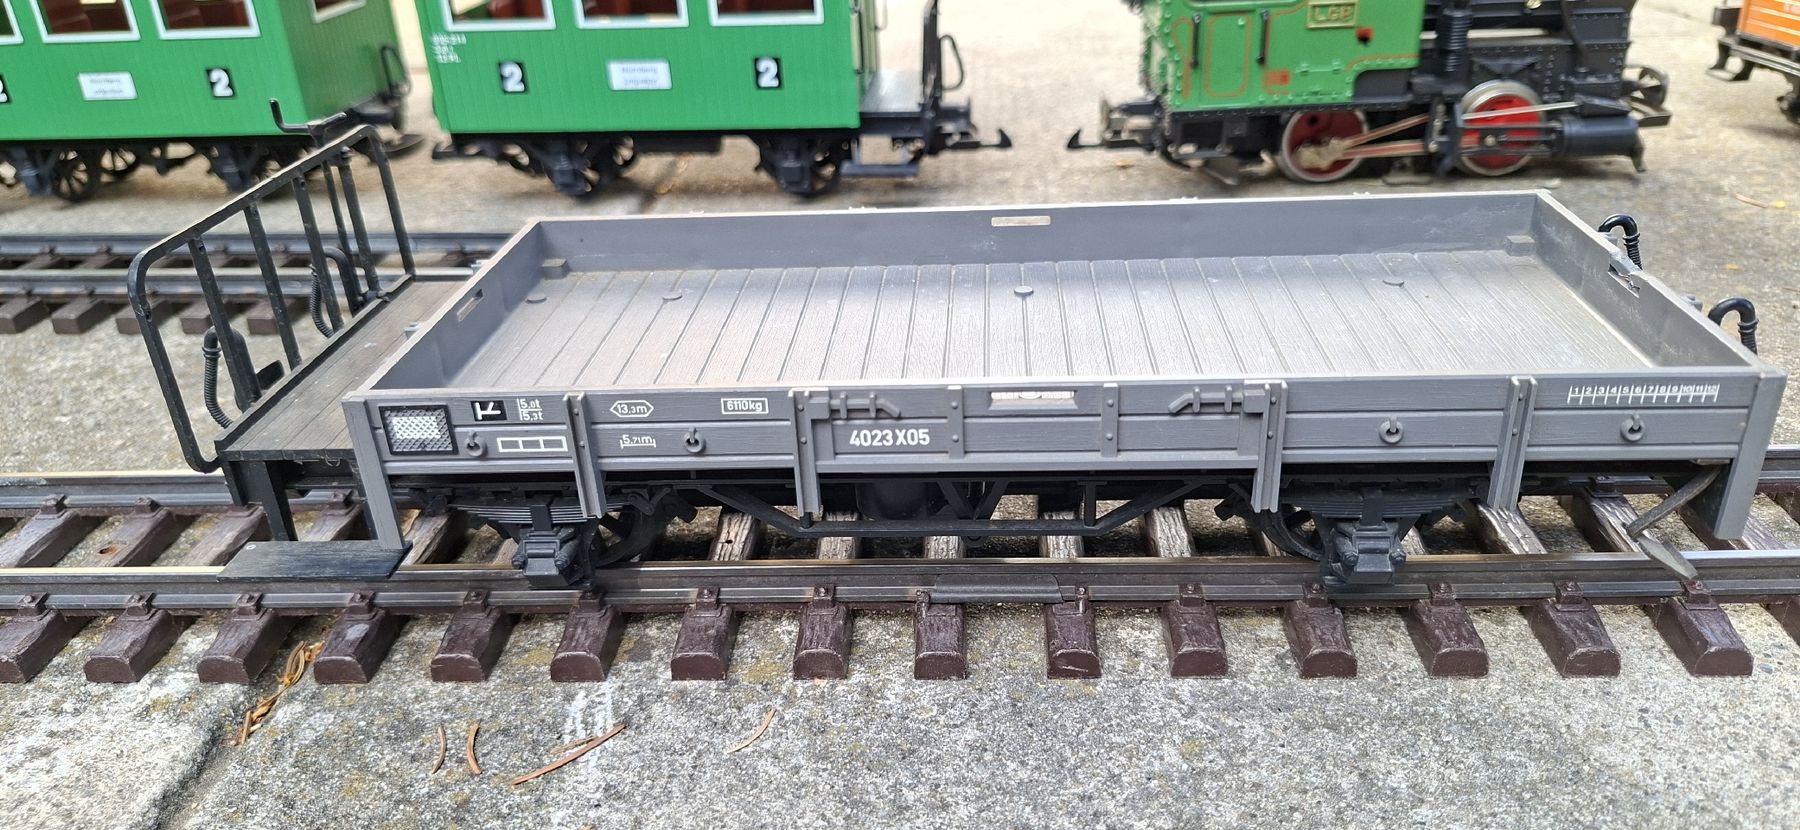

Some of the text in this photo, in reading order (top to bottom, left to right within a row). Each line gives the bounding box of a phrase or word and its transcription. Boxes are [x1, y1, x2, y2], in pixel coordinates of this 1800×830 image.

[210, 68, 233, 97] 2
[500, 62, 525, 92] 2
[757, 57, 779, 88] 2
[1574, 386, 1579, 395] 1
[1585, 386, 1592, 395] 2
[1598, 386, 1605, 394] 3
[1622, 386, 1629, 394] 5
[1635, 386, 1641, 394] 6
[1647, 385, 1654, 393] 7
[1659, 385, 1667, 393] 8
[1671, 385, 1679, 393] 9
[727, 400, 763, 412] 6110kg
